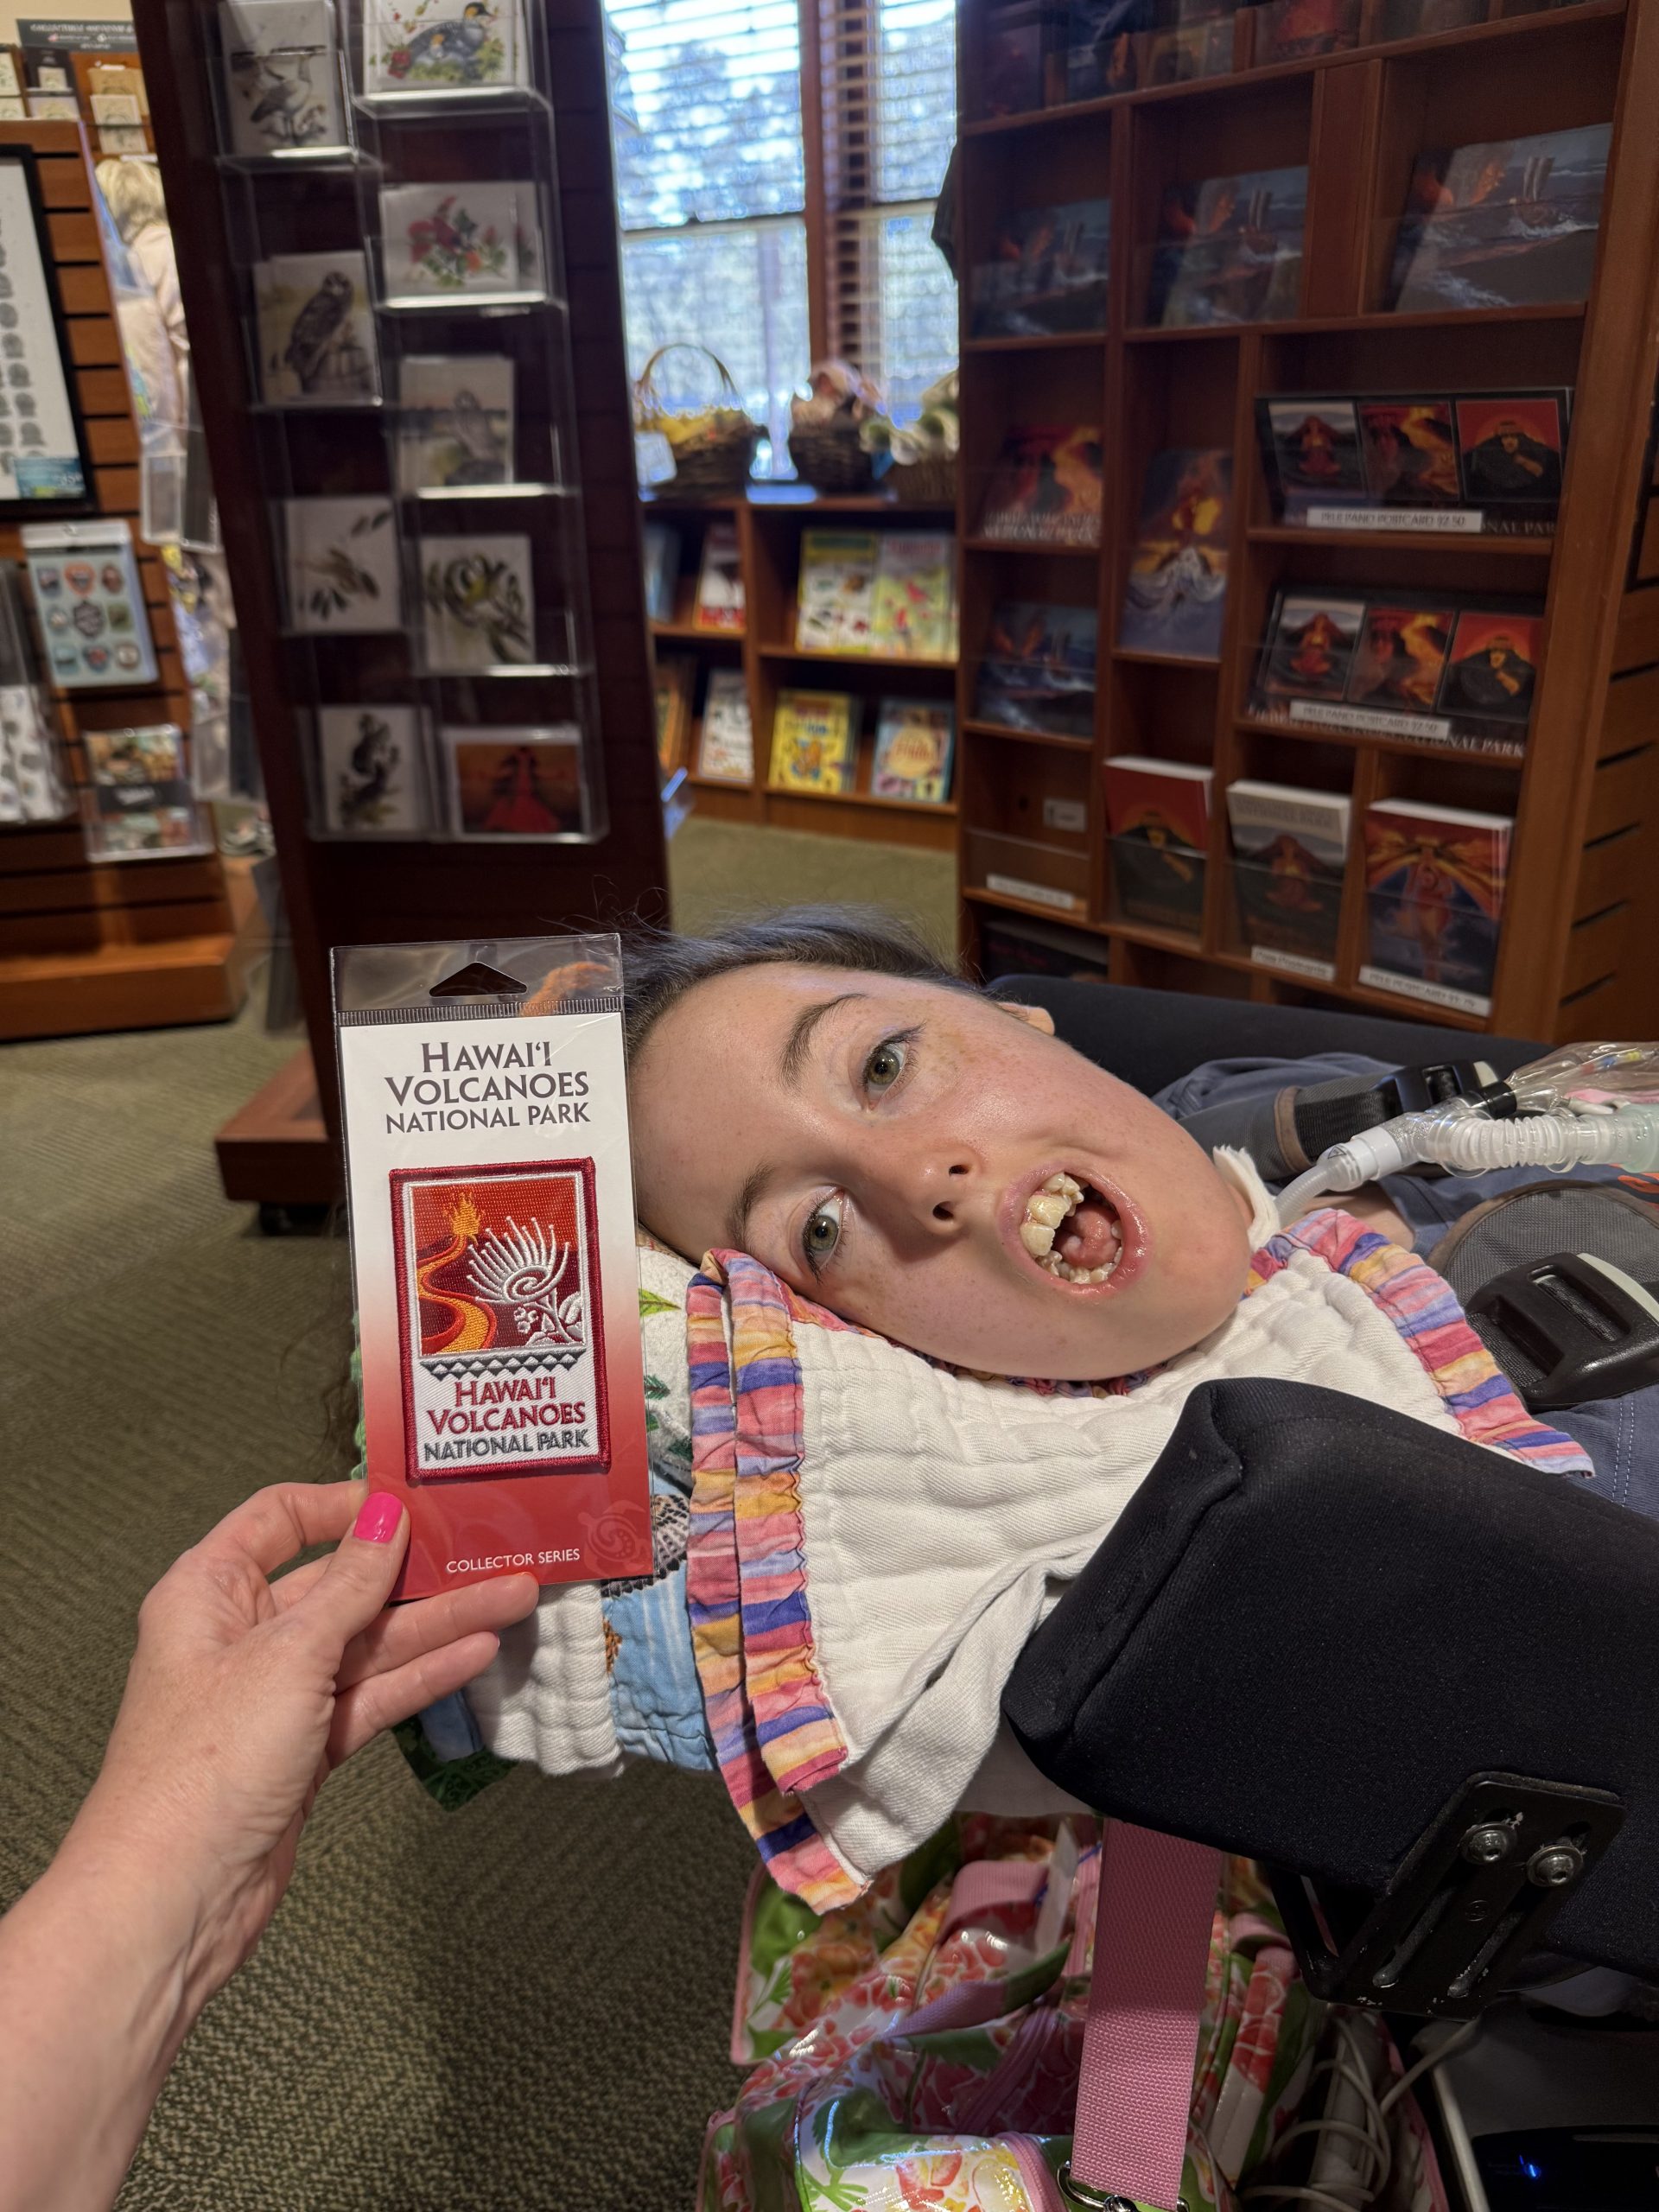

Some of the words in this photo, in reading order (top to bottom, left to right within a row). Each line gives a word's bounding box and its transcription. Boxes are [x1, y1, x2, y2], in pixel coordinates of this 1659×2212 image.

[384, 1071, 589, 1107] VOLCANOES
[385, 1106, 520, 1135] NATIONAL
[527, 1102, 591, 1126] PARK
[427, 1401, 586, 1435] VOLCANOES
[423, 1433, 533, 1462] NATIONAL
[537, 1428, 589, 1452] PARK
[446, 1553, 535, 1573] COLLECTOR
[538, 1548, 580, 1564] SERIES
